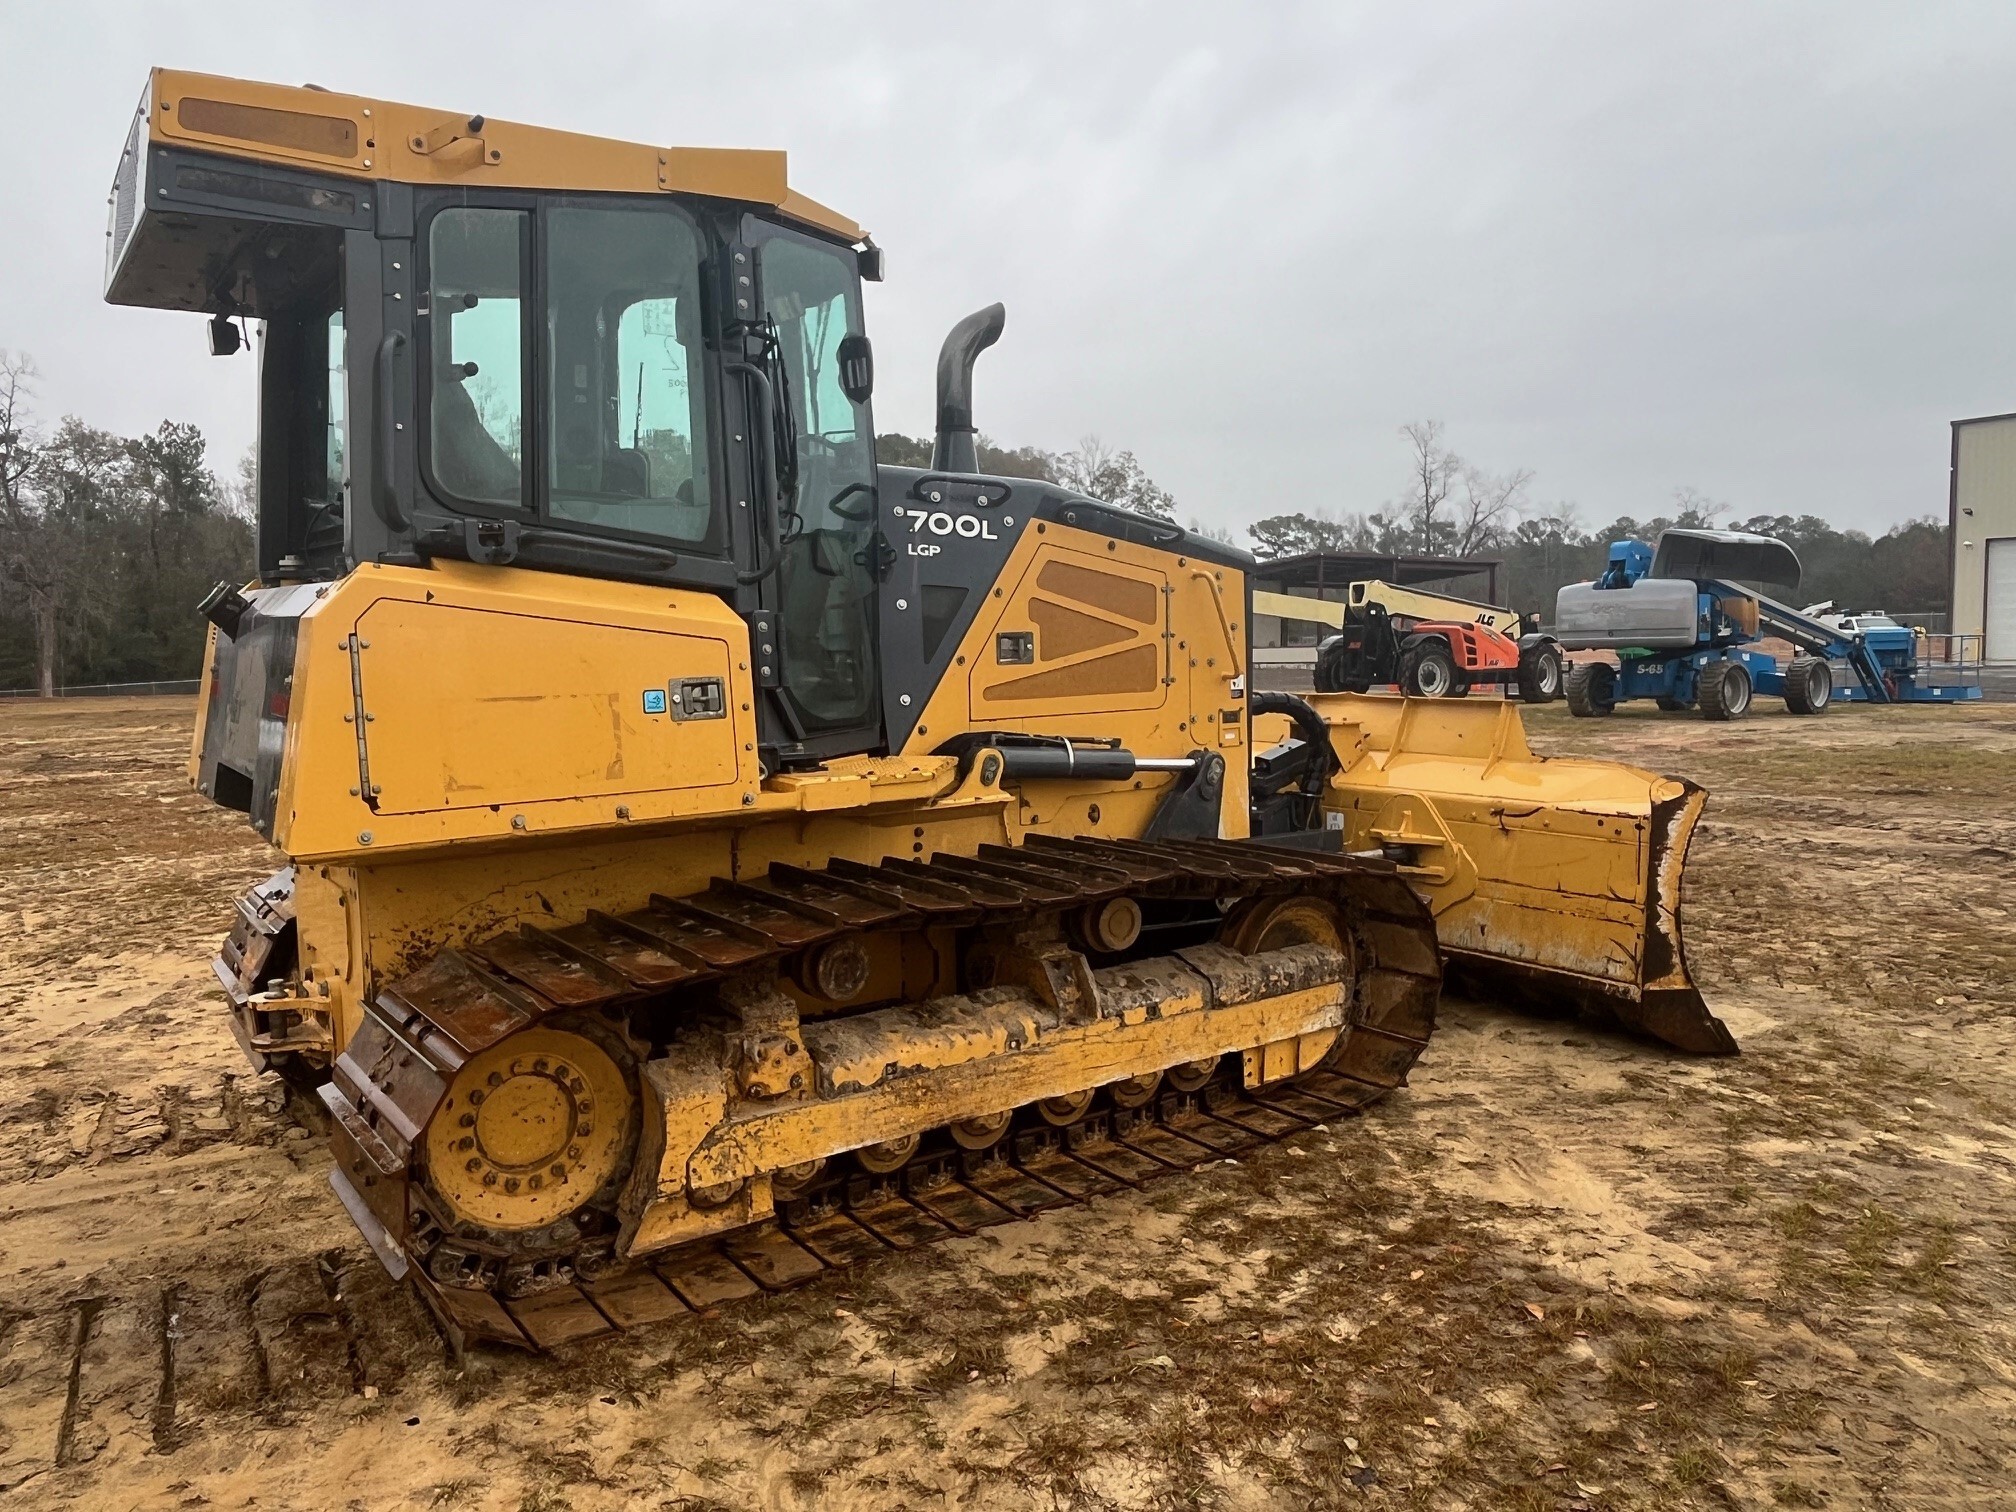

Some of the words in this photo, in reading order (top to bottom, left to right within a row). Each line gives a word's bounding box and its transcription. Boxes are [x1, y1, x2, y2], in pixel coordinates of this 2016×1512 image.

[906, 510, 998, 540] 700L
[908, 543, 941, 557] LGP
[1475, 613, 1495, 626] JLG
[1637, 664, 1663, 674] S-65
